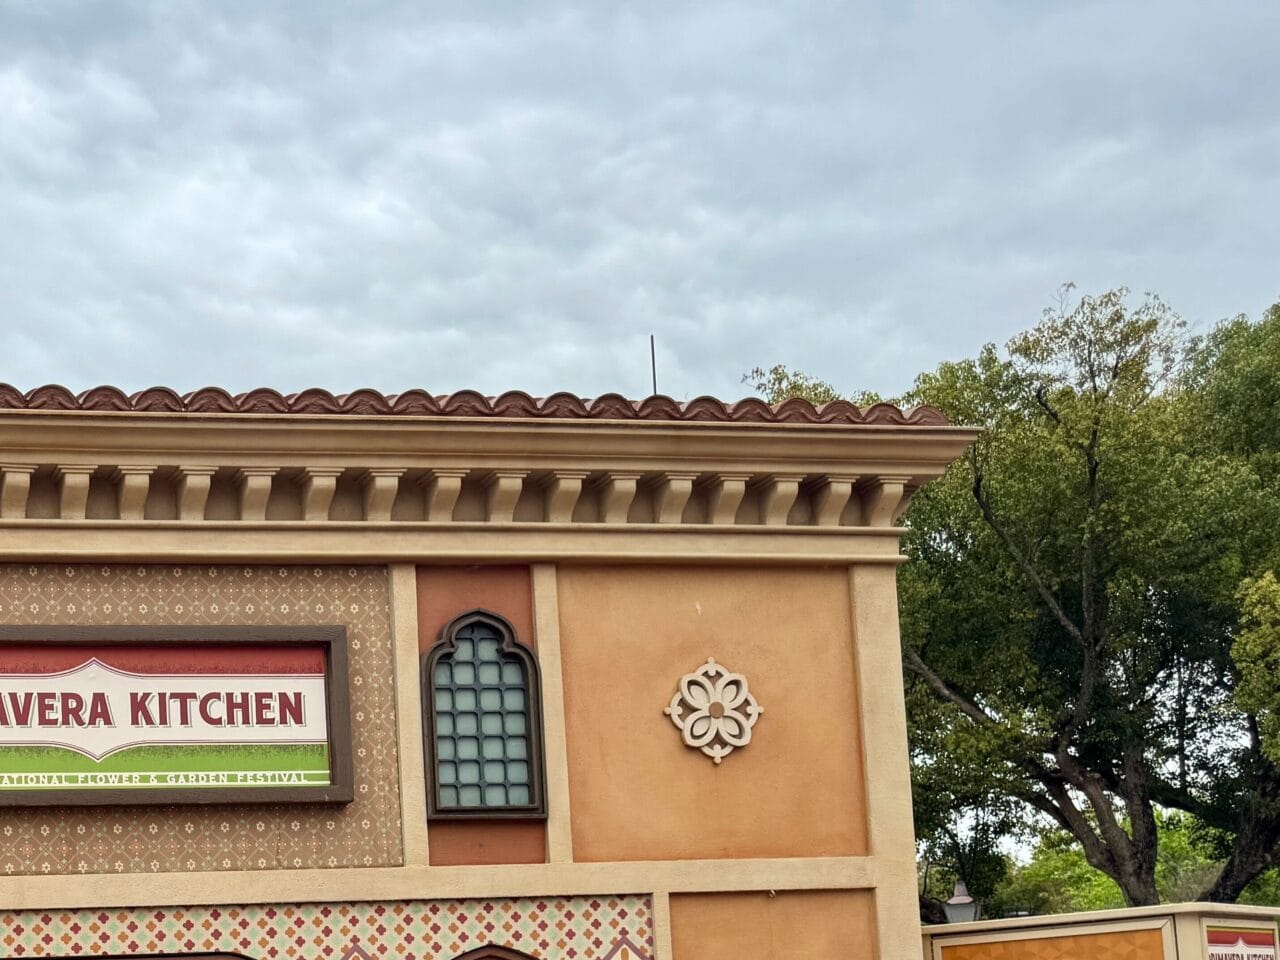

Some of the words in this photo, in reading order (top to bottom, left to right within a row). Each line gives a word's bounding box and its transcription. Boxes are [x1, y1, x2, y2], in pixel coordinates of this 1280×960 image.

[129, 692, 305, 727] KITCHEN
[77, 774, 140, 784] FLOWER
[149, 774, 158, 784] &
[166, 774, 229, 784] GARDEN
[237, 773, 308, 783] FESTIVAL
